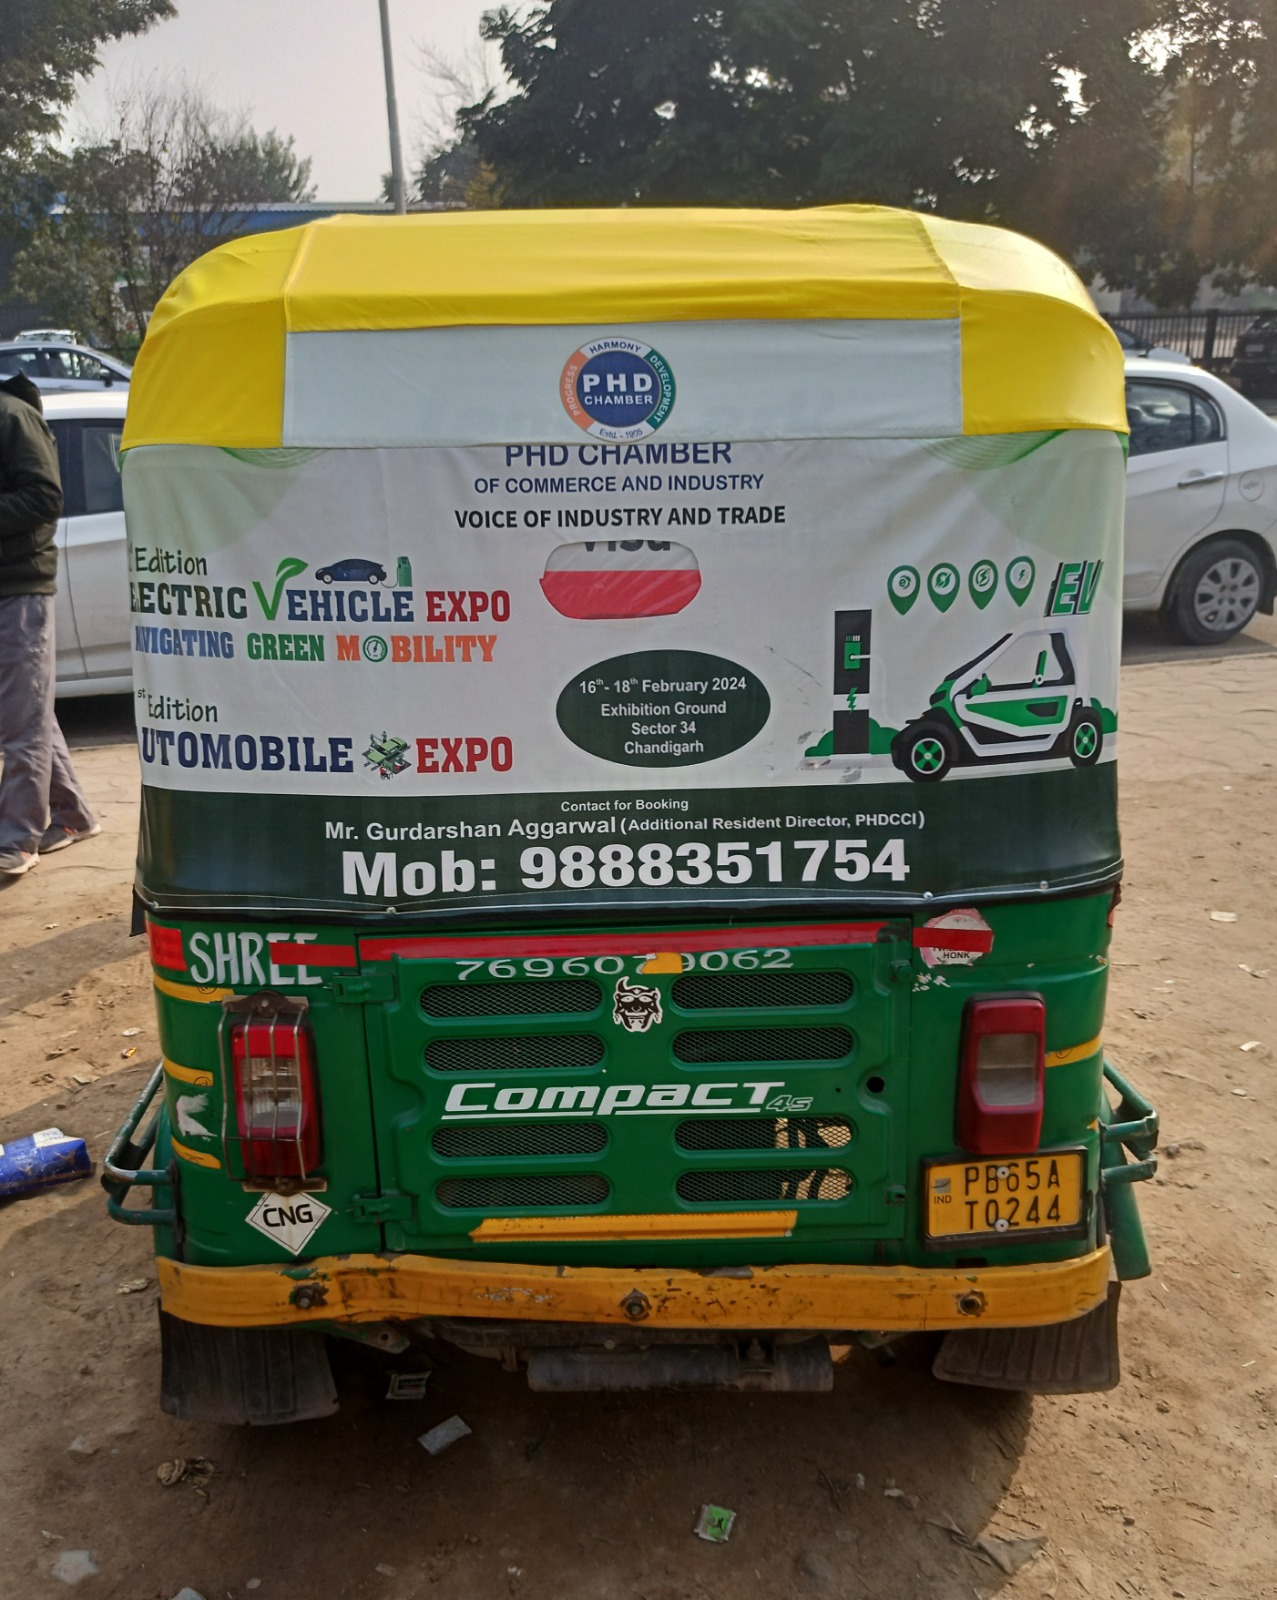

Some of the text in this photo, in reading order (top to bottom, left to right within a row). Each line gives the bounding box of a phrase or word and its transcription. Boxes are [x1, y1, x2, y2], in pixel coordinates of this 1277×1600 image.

[589, 341, 642, 354] HARMONY
[564, 364, 581, 417] PROGRESS
[582, 373, 653, 393] PHD
[649, 355, 672, 424] DEVELOPMENT
[584, 395, 653, 405] CHAMBER
[625, 428, 643, 439] 1905
[505, 442, 732, 467] PHD CHAMBER
[474, 474, 764, 494] OF COMMERCE AND INDUSTRY
[454, 506, 786, 528] VOICE OF INDUSTRY AND TRADE
[135, 547, 207, 576] Edition
[252, 563, 414, 622] VEHICLE
[426, 590, 511, 622] EXPO
[1044, 560, 1103, 617] EV
[247, 633, 325, 661] GREEN
[642, 678, 708, 695] February
[712, 677, 747, 691] 2024
[148, 694, 218, 723] Edition
[601, 701, 727, 717] Exhibition Ground
[631, 721, 696, 735] Sector 34
[142, 727, 513, 774] UTOMOBILE EXPO
[624, 740, 704, 756] Chandigarh
[560, 798, 689, 812] Contact for Booking
[325, 811, 925, 841] Mr. Gurdarshan Aggarwal (Additional Resident Director, PHDCCI)
[342, 838, 911, 898] Mob: 9888351754
[943, 951, 970, 959] HONK
[965, 1159, 1060, 1196] PB65A
[934, 1194, 952, 1204] IND
[262, 1203, 314, 1228] CNG
